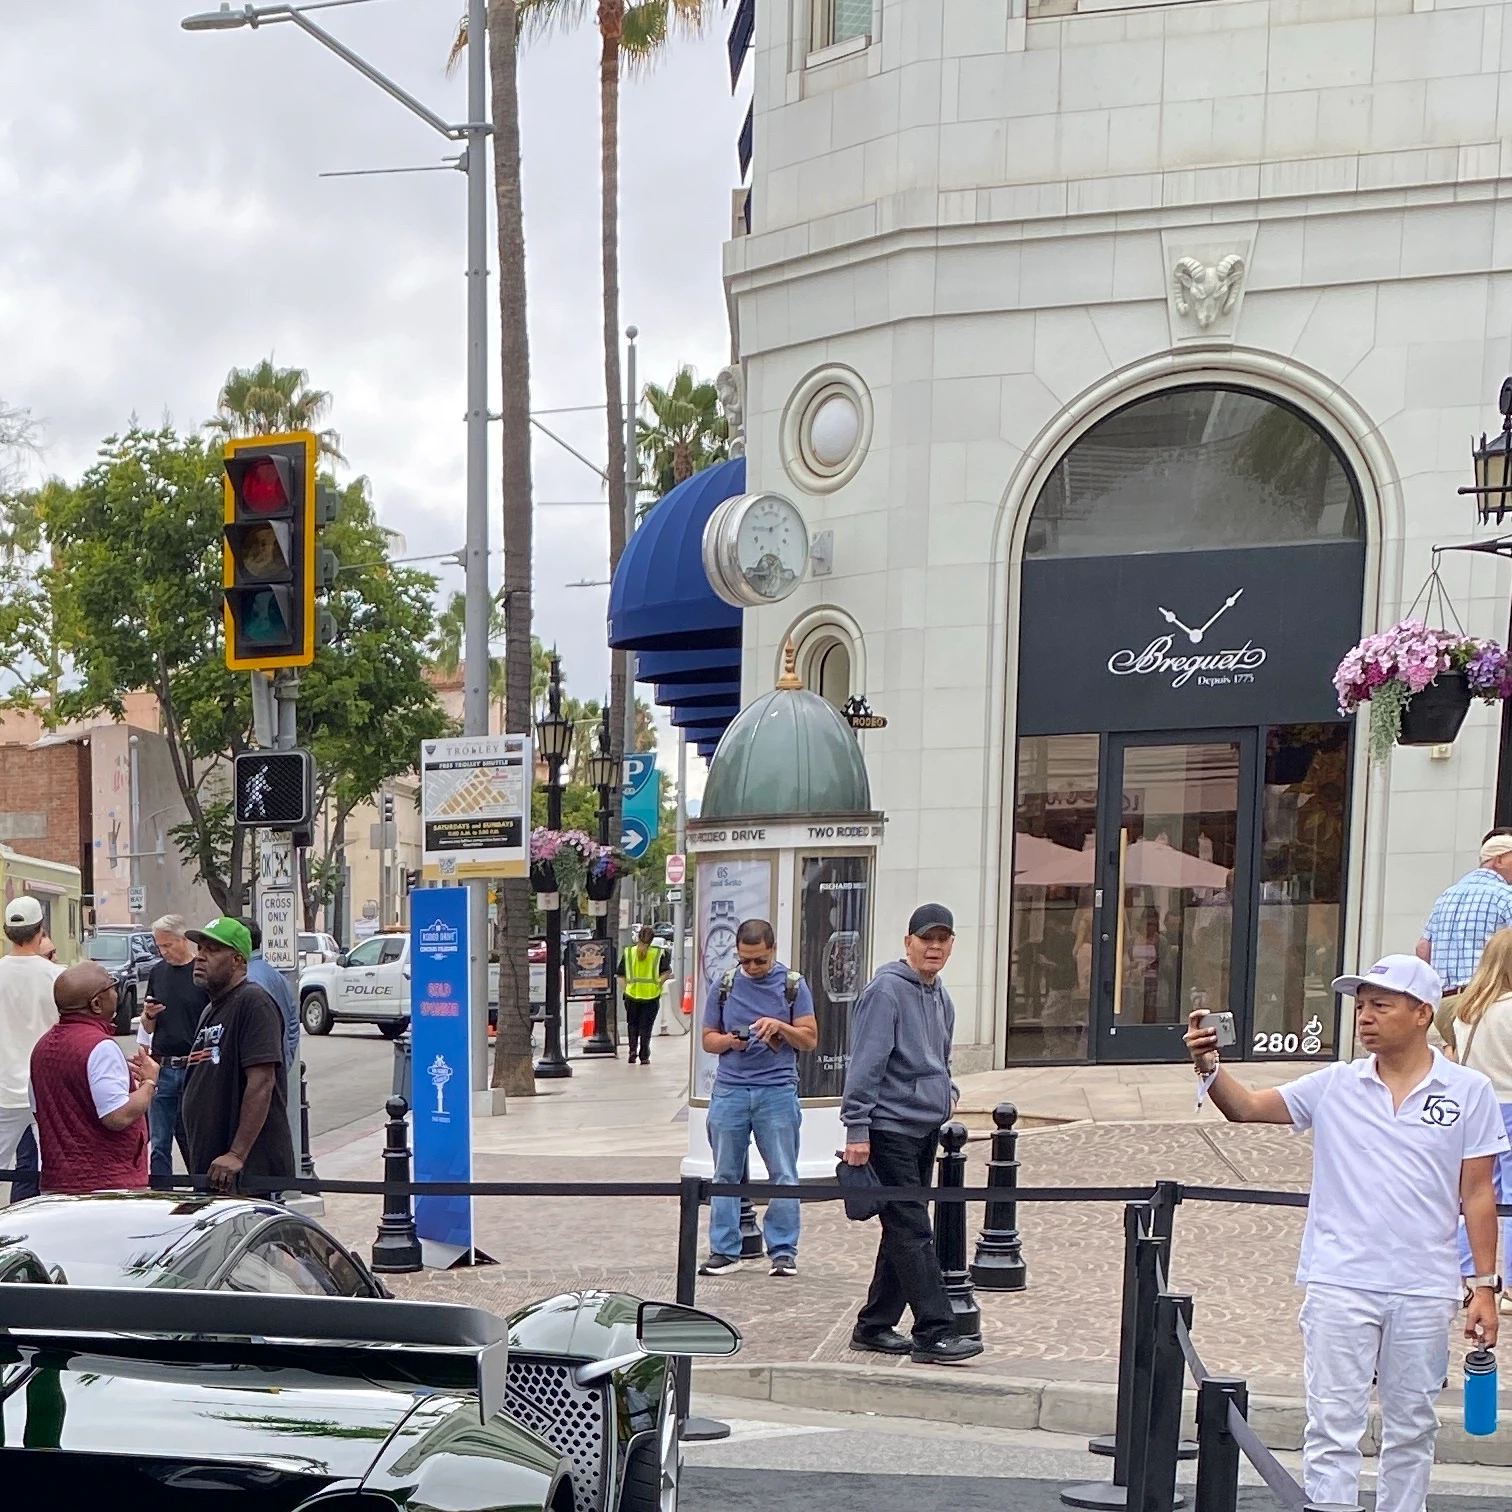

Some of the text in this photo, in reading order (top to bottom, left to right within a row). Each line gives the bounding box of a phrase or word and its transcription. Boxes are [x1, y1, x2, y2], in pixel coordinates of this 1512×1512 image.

[1107, 633, 1267, 688] Breguet
[1197, 675, 1231, 687] Depuis
[852, 716, 884, 727] RODEO
[732, 829, 766, 841] DRIVE
[807, 827, 834, 838] TWO
[837, 826, 869, 837] RODEO
[265, 898, 291, 909] CROSS
[268, 911, 288, 922] ONLY
[273, 925, 284, 936] ON
[268, 939, 289, 949] WALK
[264, 952, 292, 962] SIGNAL
[345, 985, 393, 996] POLICE
[1253, 1032, 1298, 1053] 280
